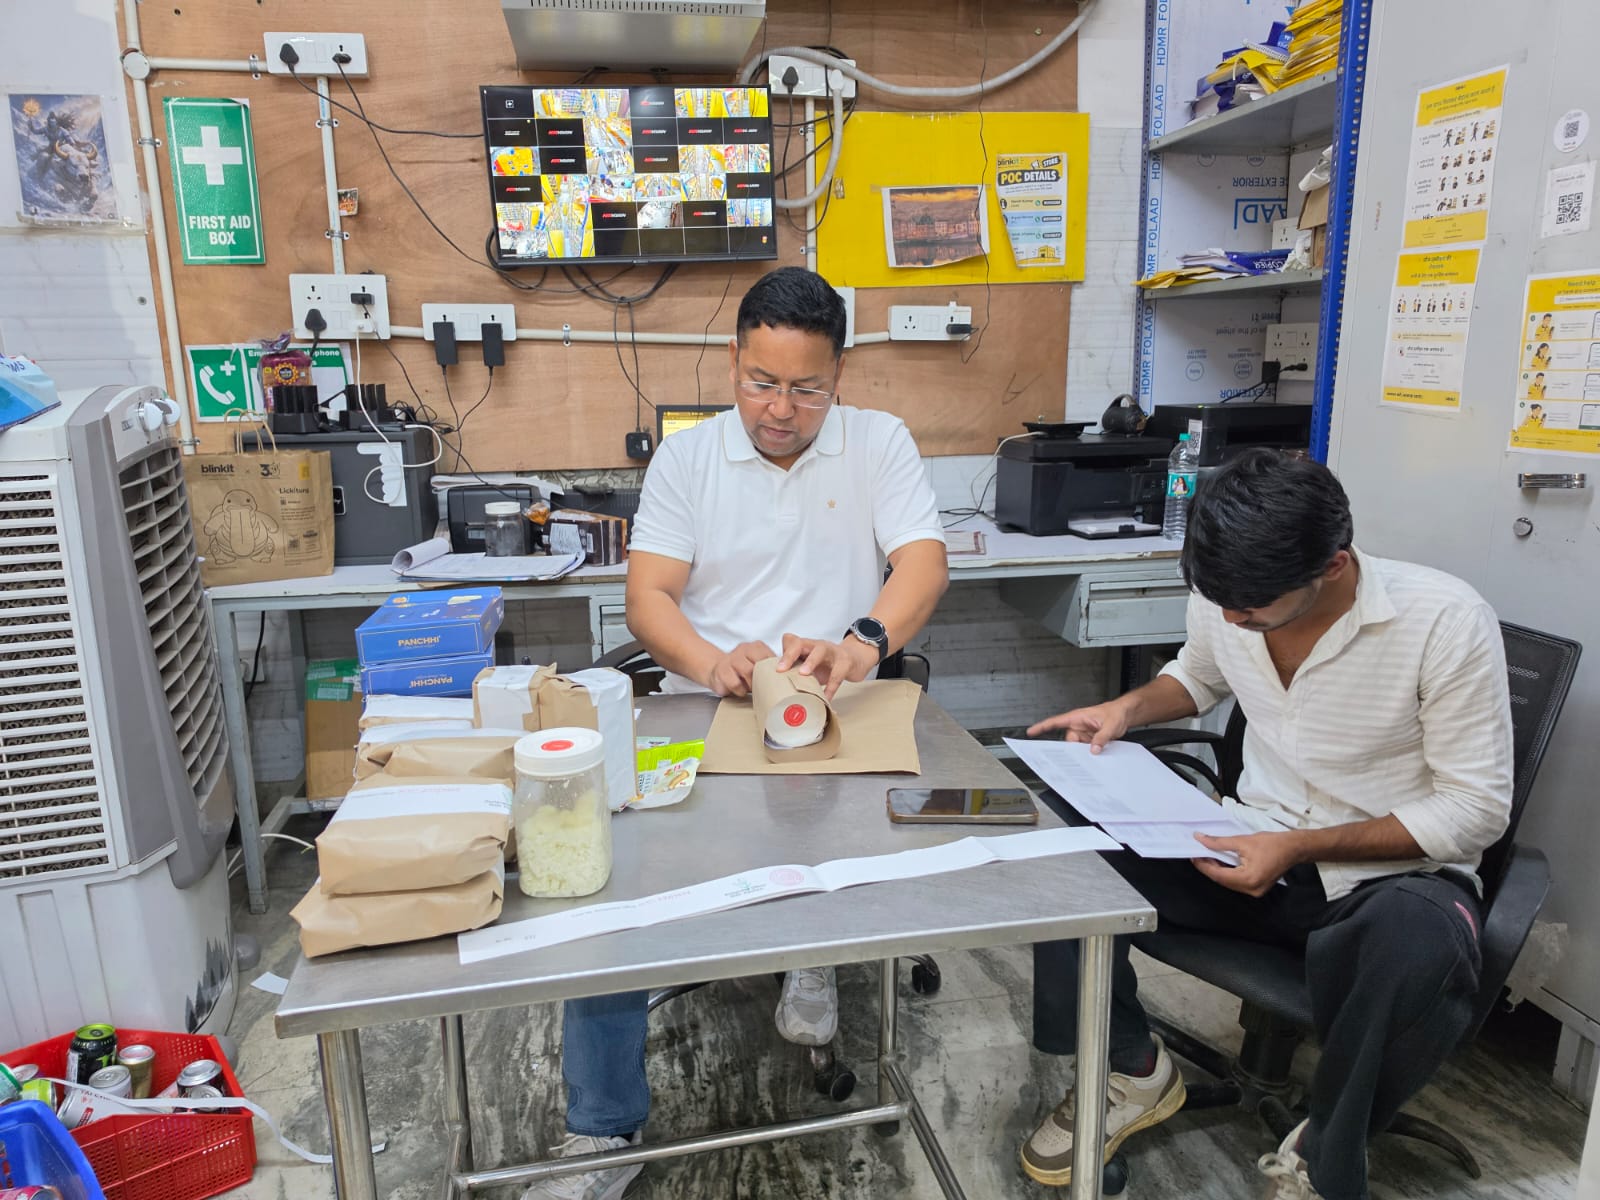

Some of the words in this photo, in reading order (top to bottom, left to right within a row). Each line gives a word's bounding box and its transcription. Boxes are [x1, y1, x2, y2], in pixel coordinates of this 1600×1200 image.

[1156, 27, 1167, 66] HDMR
[1153, 84, 1164, 137] FOLAAD
[1151, 152, 1161, 180] HDM
[1001, 172, 1022, 185] POC
[1024, 170, 1056, 182] DETAILS
[1232, 177, 1276, 187] EXTERIOR
[189, 215, 226, 230] FIRST
[229, 215, 251, 230] AID
[1148, 197, 1159, 249] FOLAAD
[209, 231, 236, 246] BOX
[1147, 254, 1157, 281] DMR
[1142, 306, 1154, 356] FOLAAD
[1141, 356, 1151, 395] HDMR
[201, 464, 235, 474] blinkit
[398, 636, 440, 647] PANCHHI
[411, 676, 453, 688] PANCHHI
